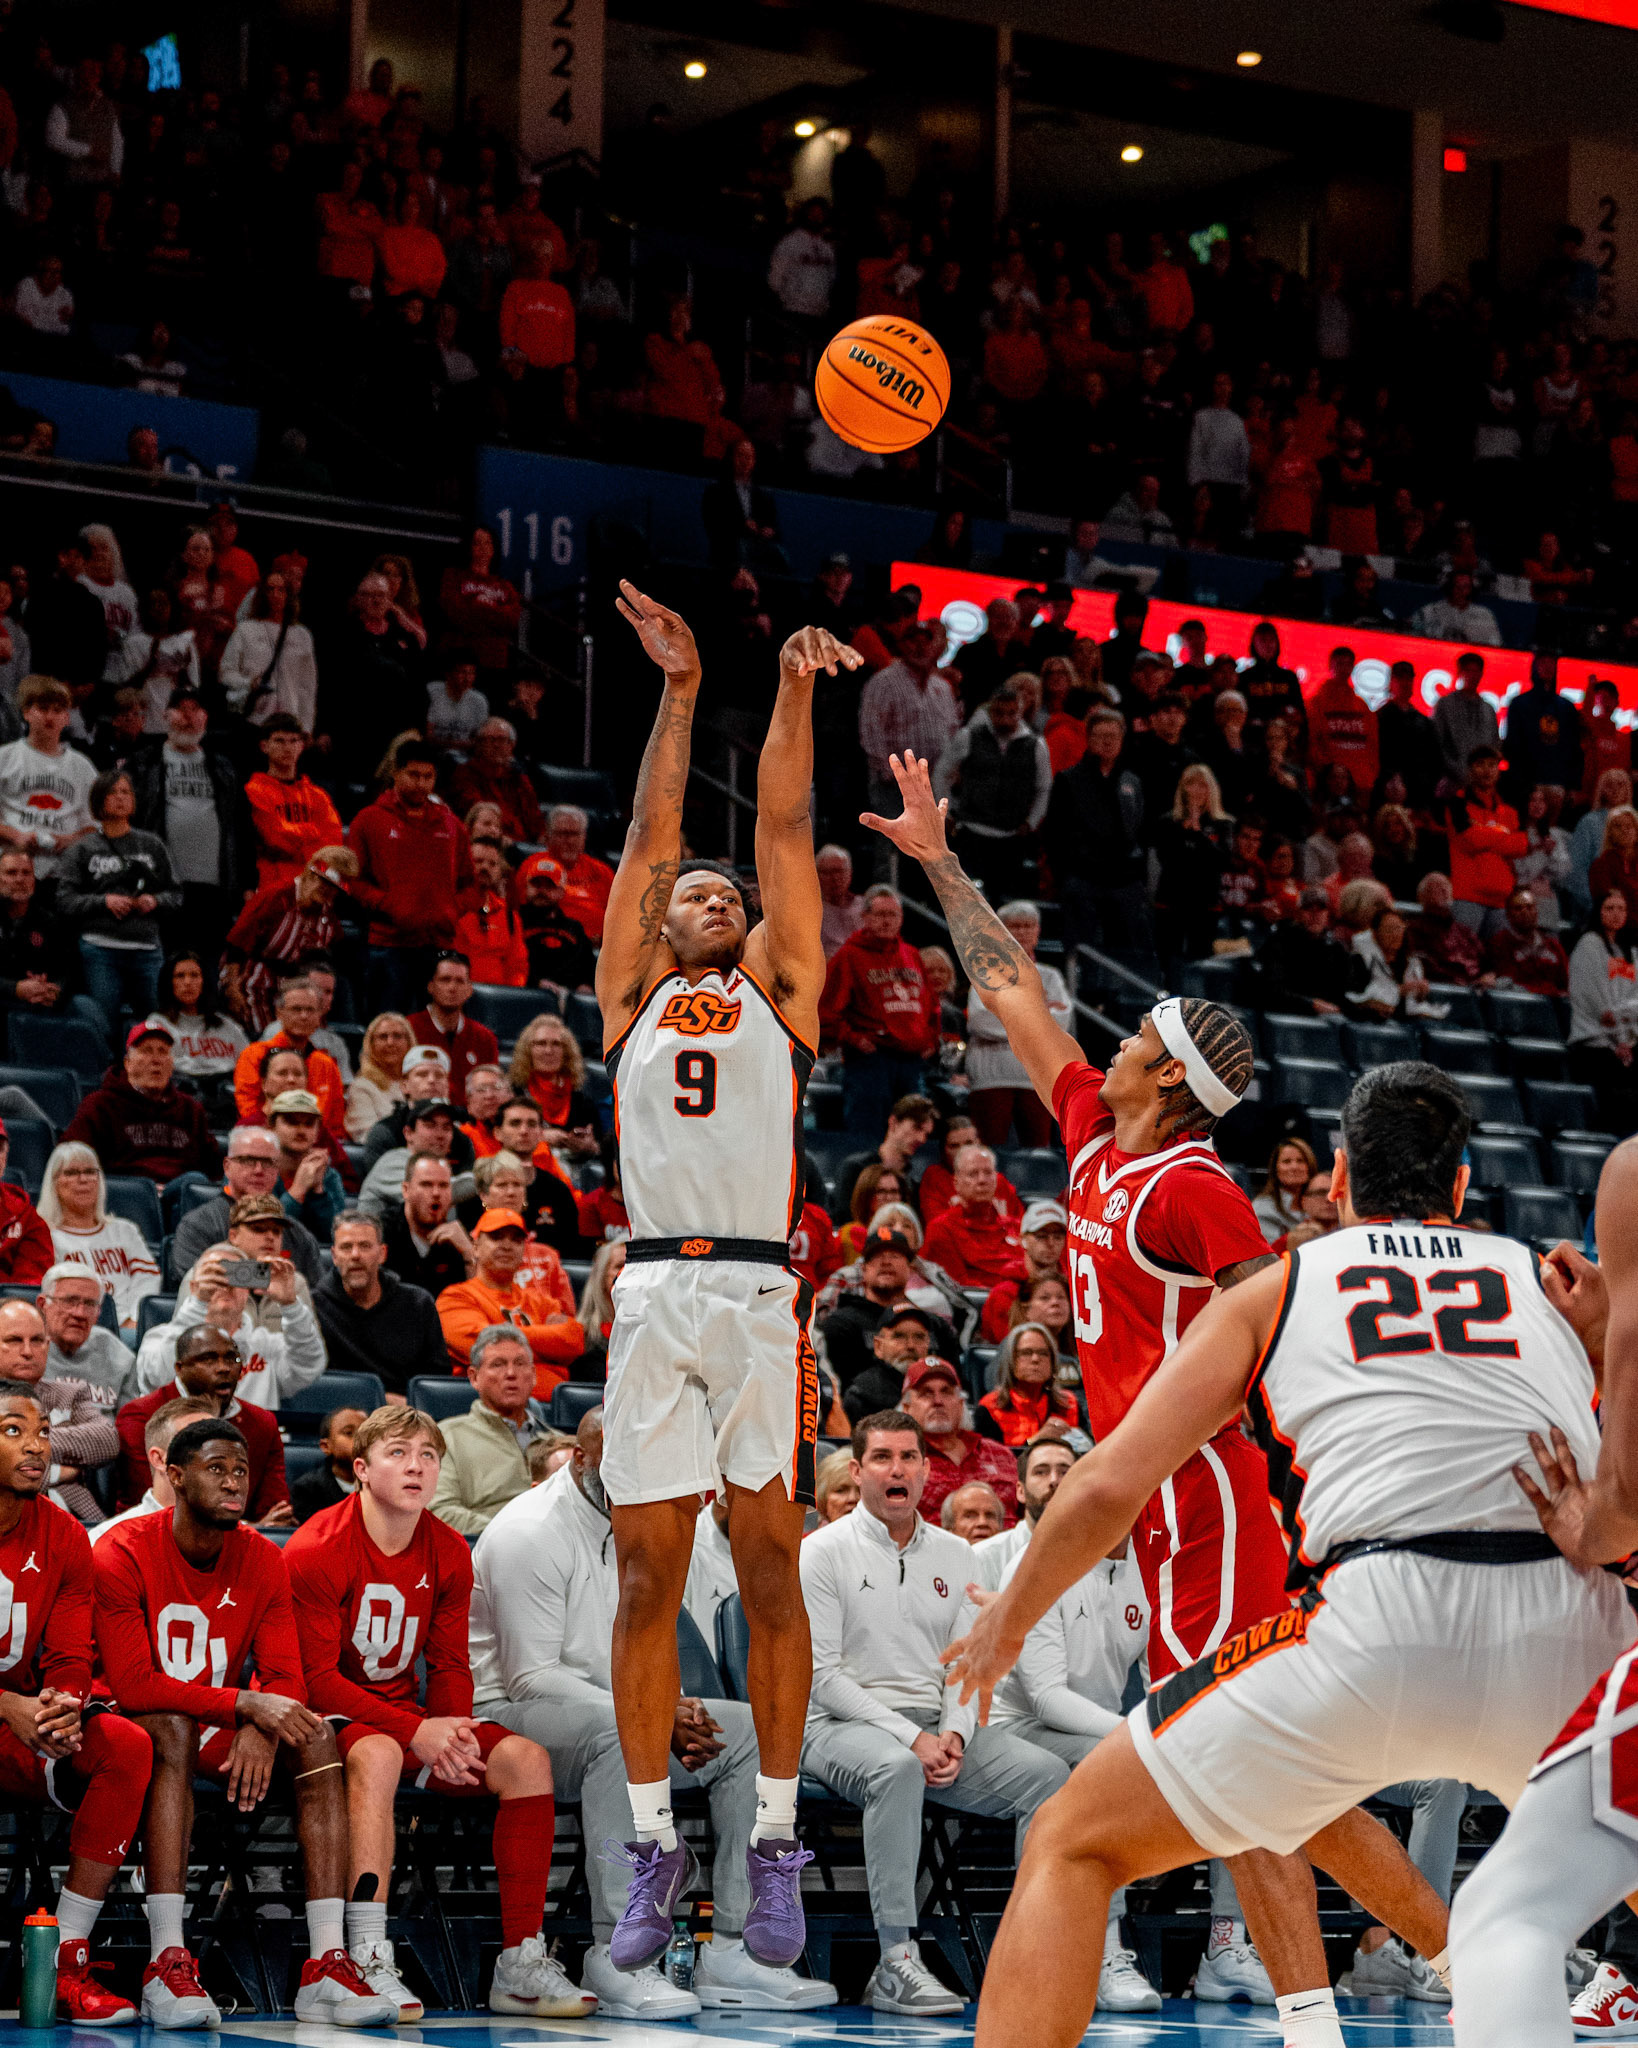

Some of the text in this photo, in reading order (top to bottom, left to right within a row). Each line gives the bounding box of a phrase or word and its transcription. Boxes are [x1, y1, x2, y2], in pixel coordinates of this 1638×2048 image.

[547, 0, 575, 126] 224
[848, 345, 925, 409] Wilson
[496, 507, 574, 566] 116
[656, 990, 742, 1038] OSU
[673, 1049, 717, 1118] 9
[1104, 1190, 1127, 1220] SEC
[680, 1238, 714, 1257] OSU
[1367, 1233, 1463, 1259] FALLAH
[1069, 1248, 1104, 1344] 13
[1336, 1265, 1521, 1364] 22
[798, 1328, 818, 1445] COWBOYS
[933, 1577, 948, 1599] OU
[1125, 1604, 1143, 1631] OU
[351, 1583, 420, 1681] OU
